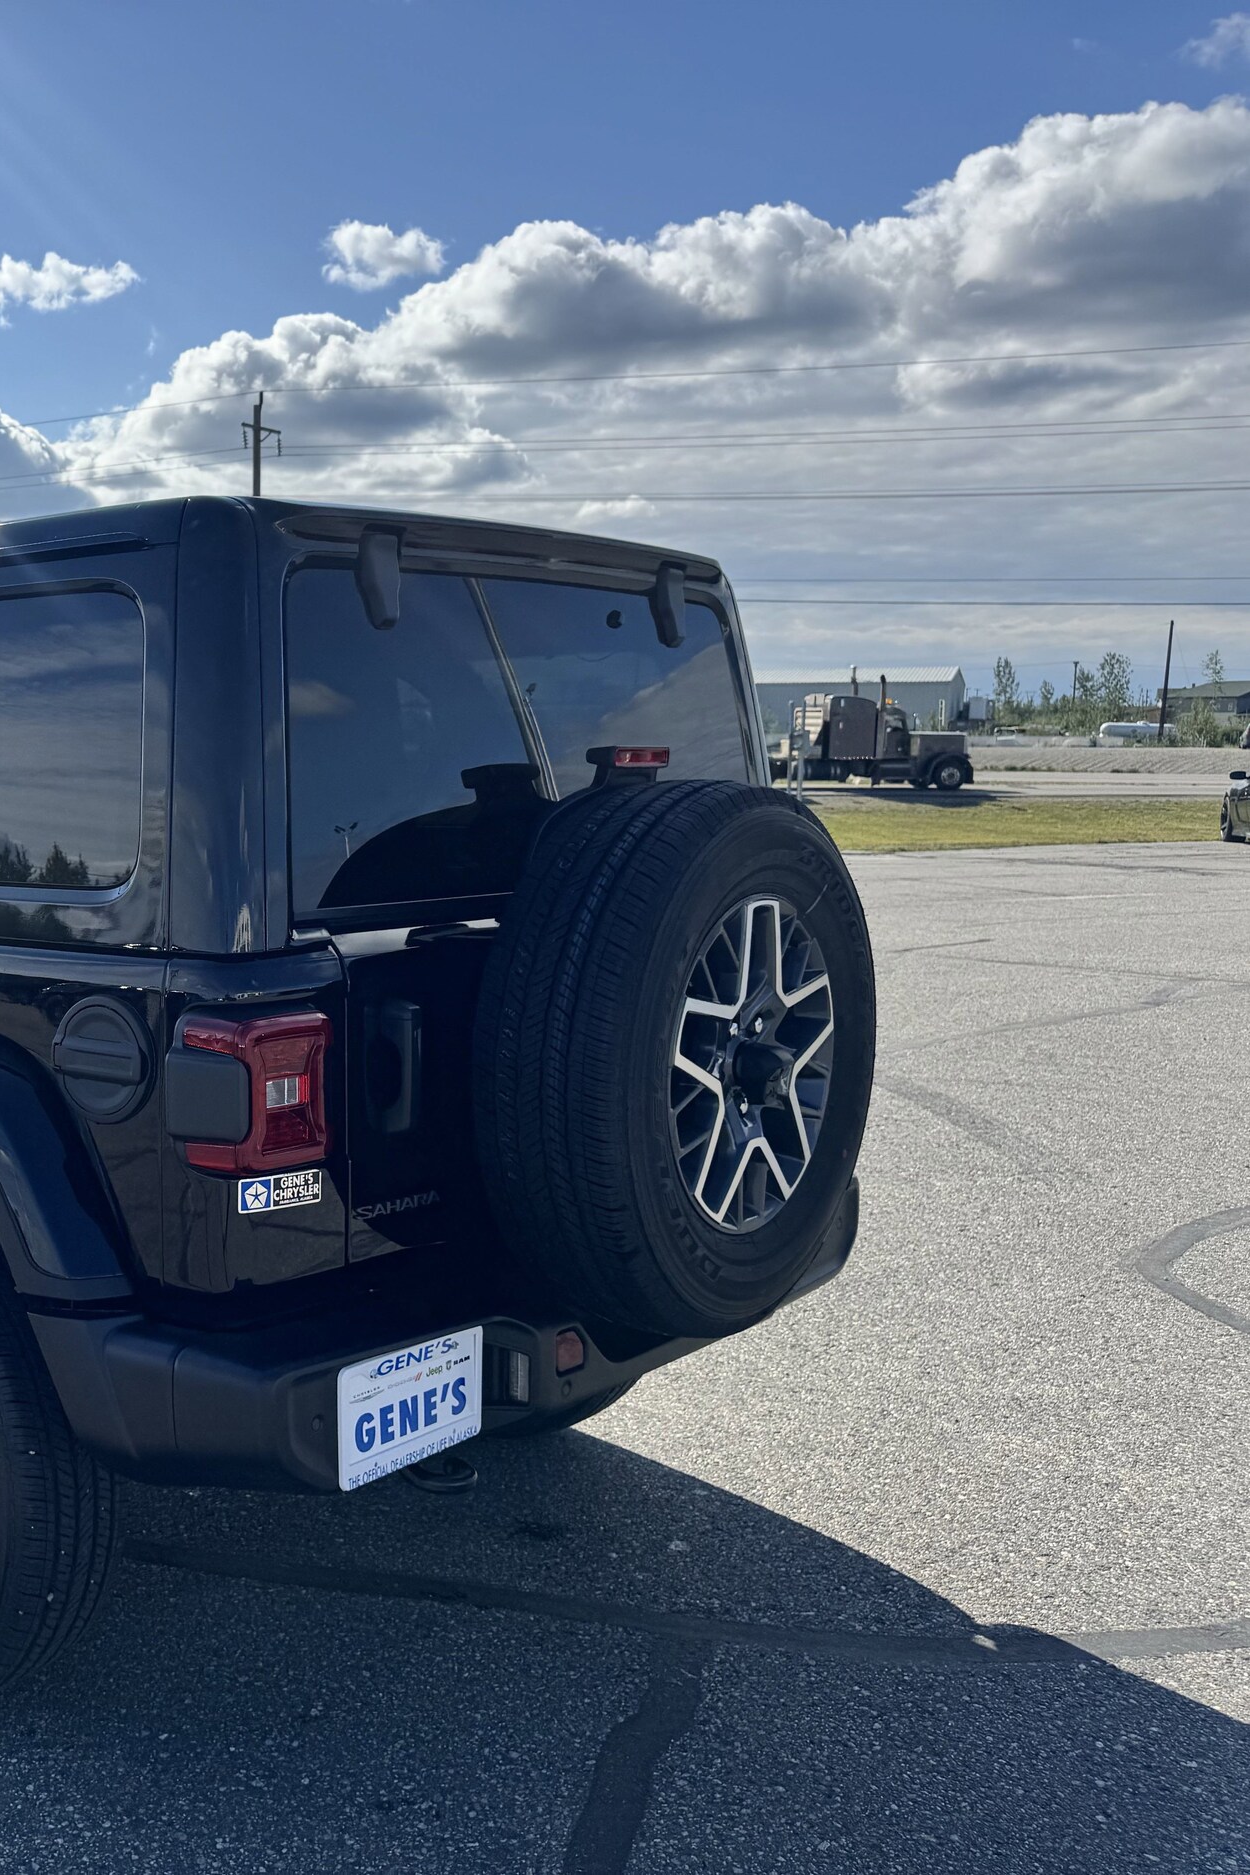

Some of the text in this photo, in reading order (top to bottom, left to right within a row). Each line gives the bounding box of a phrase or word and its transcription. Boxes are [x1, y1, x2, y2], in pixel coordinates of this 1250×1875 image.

[273, 1183, 319, 1201] CHRYSLER
[280, 1173, 314, 1188] GENE'S
[354, 1190, 440, 1220] SAHARA
[376, 1338, 452, 1376] GENE'S
[426, 1365, 443, 1377] Jeep
[453, 1355, 470, 1366] RAM
[354, 1376, 466, 1453] GENE'S
[348, 1473, 362, 1489] THE
[362, 1464, 388, 1483] OFFICIAL
[390, 1447, 425, 1469] DEALERSHIP
[426, 1444, 436, 1456] OF
[436, 1437, 447, 1453] LIFE
[456, 1426, 477, 1443] ALASKA
